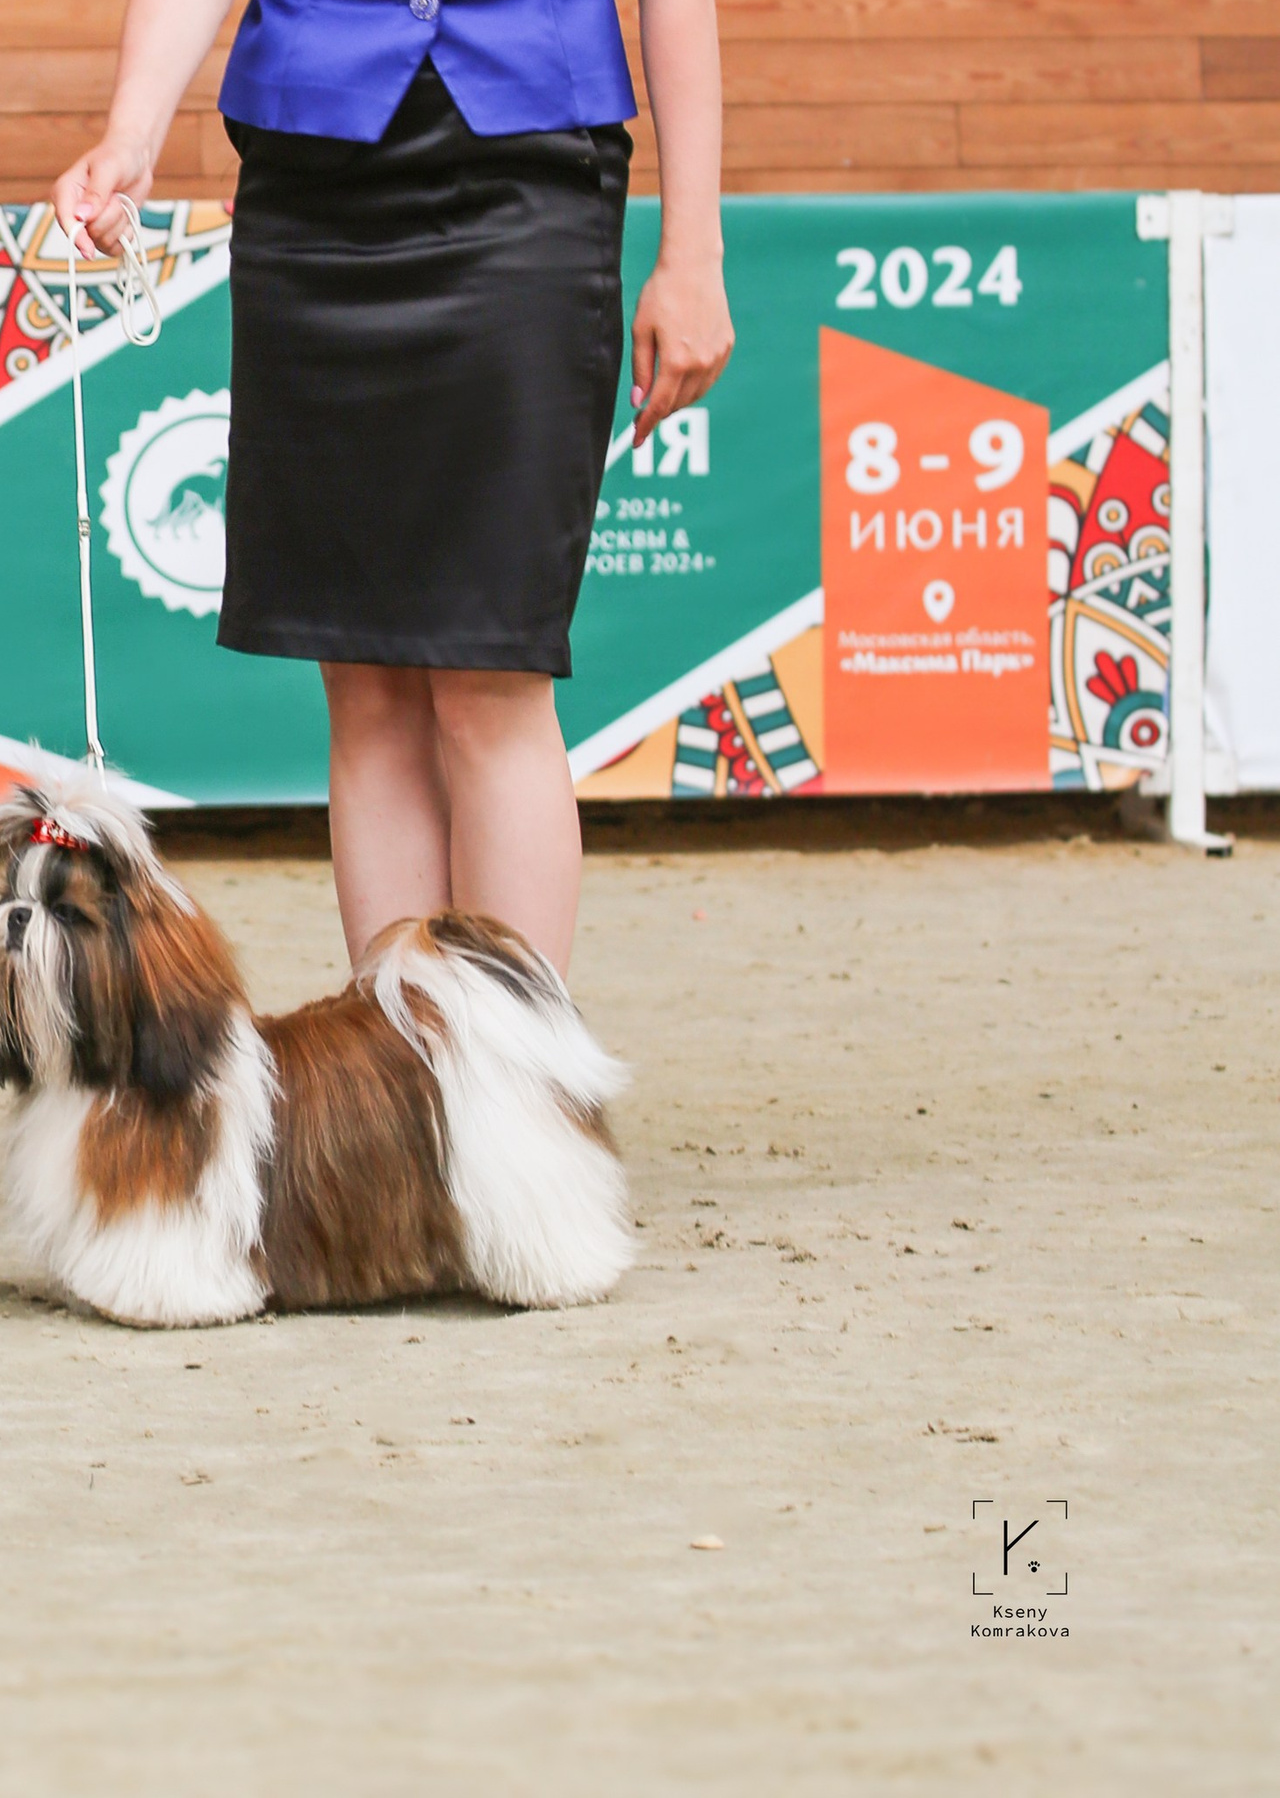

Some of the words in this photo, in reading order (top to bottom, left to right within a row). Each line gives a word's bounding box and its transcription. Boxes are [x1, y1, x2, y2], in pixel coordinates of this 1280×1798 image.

[835, 244, 1022, 309] 2024
[672, 528, 690, 550] &
[850, 506, 1024, 551] ИЮНЯ
[838, 630, 953, 649] Московская
[840, 649, 958, 675] «Максима
[961, 648, 1035, 678] Парк»
